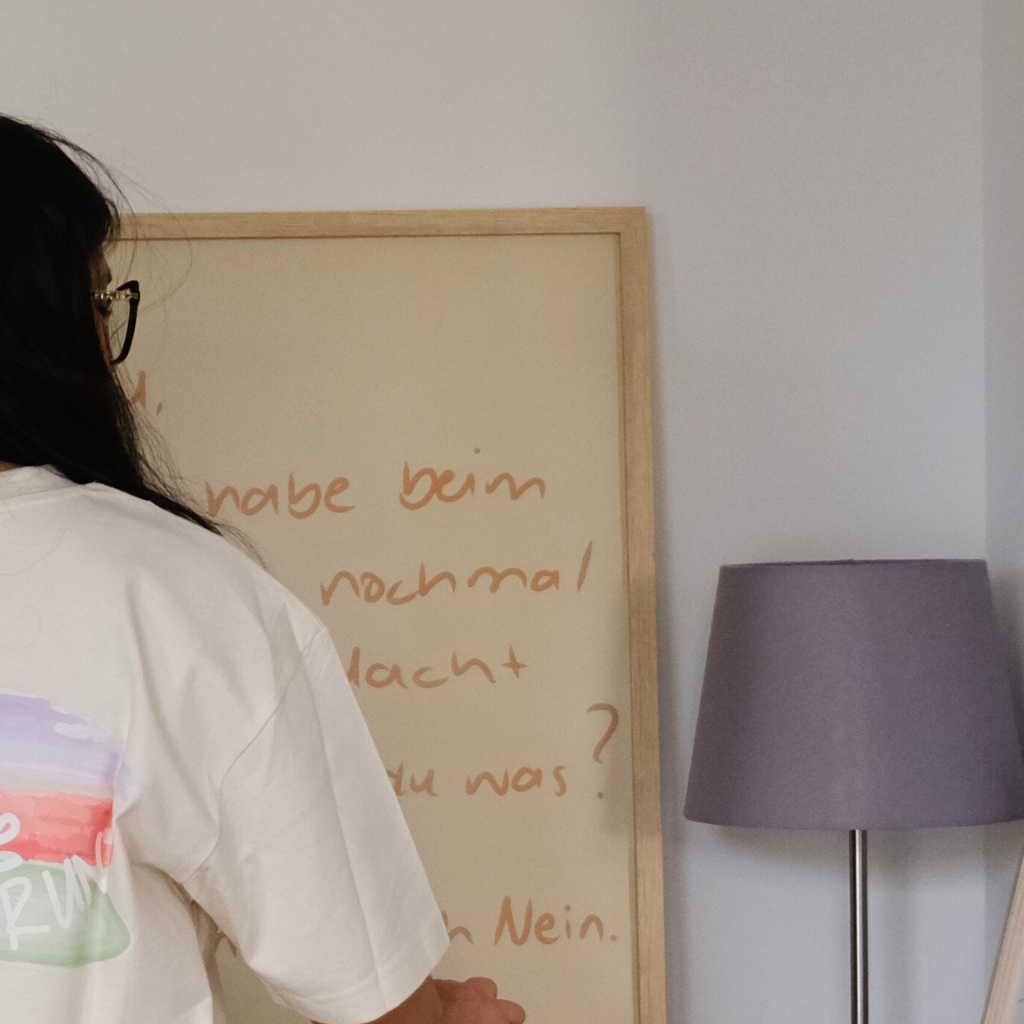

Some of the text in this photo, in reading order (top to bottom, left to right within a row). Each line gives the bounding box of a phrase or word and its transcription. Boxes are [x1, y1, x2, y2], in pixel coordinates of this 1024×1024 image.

[399, 447, 546, 511] beim
[320, 540, 593, 607] nochmal
[494, 895, 618, 947] Nein.
